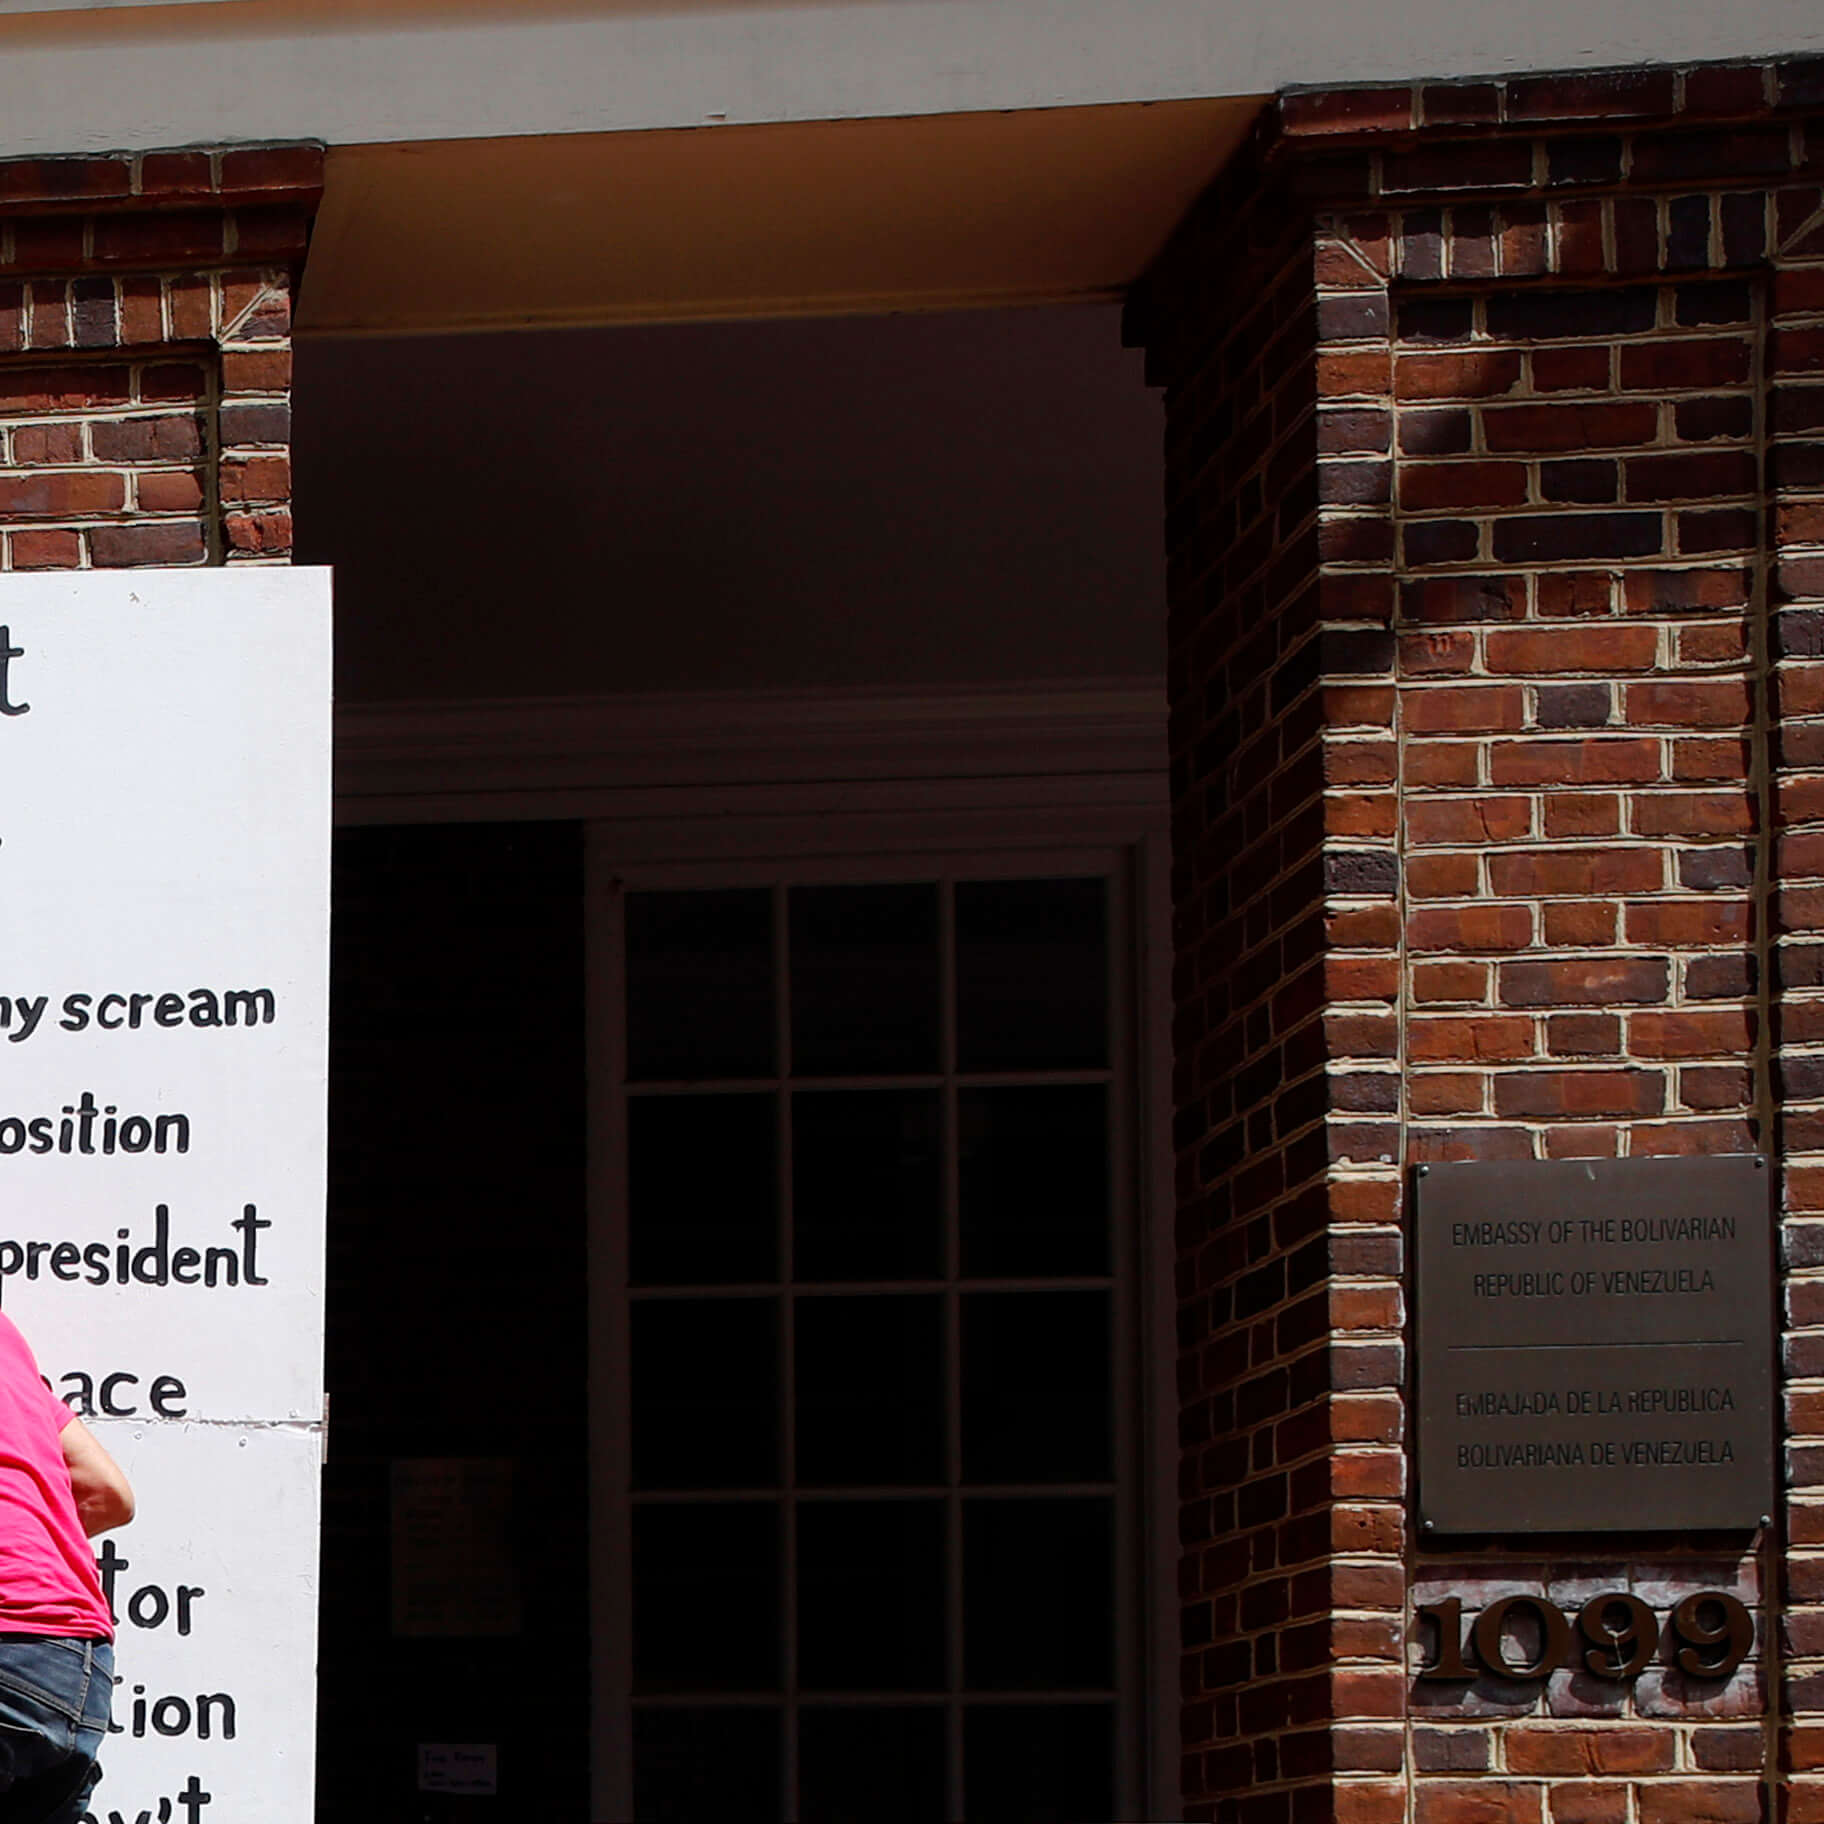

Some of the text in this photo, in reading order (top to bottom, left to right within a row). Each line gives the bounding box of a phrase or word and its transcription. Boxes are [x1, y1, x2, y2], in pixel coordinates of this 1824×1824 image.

[60, 986, 274, 1031] scream
[1452, 1217, 1736, 1246] EMBASSY OF THE BOLIVARIAN
[1474, 1269, 1714, 1297] REPUBLIC OF VENEZUELA
[1455, 1388, 1735, 1416] EMBAJADA DE LA REPUBLICA
[1458, 1440, 1734, 1468] BOLIVARIANA DE VENEZUELA
[1418, 1592, 1754, 1680] 1099
